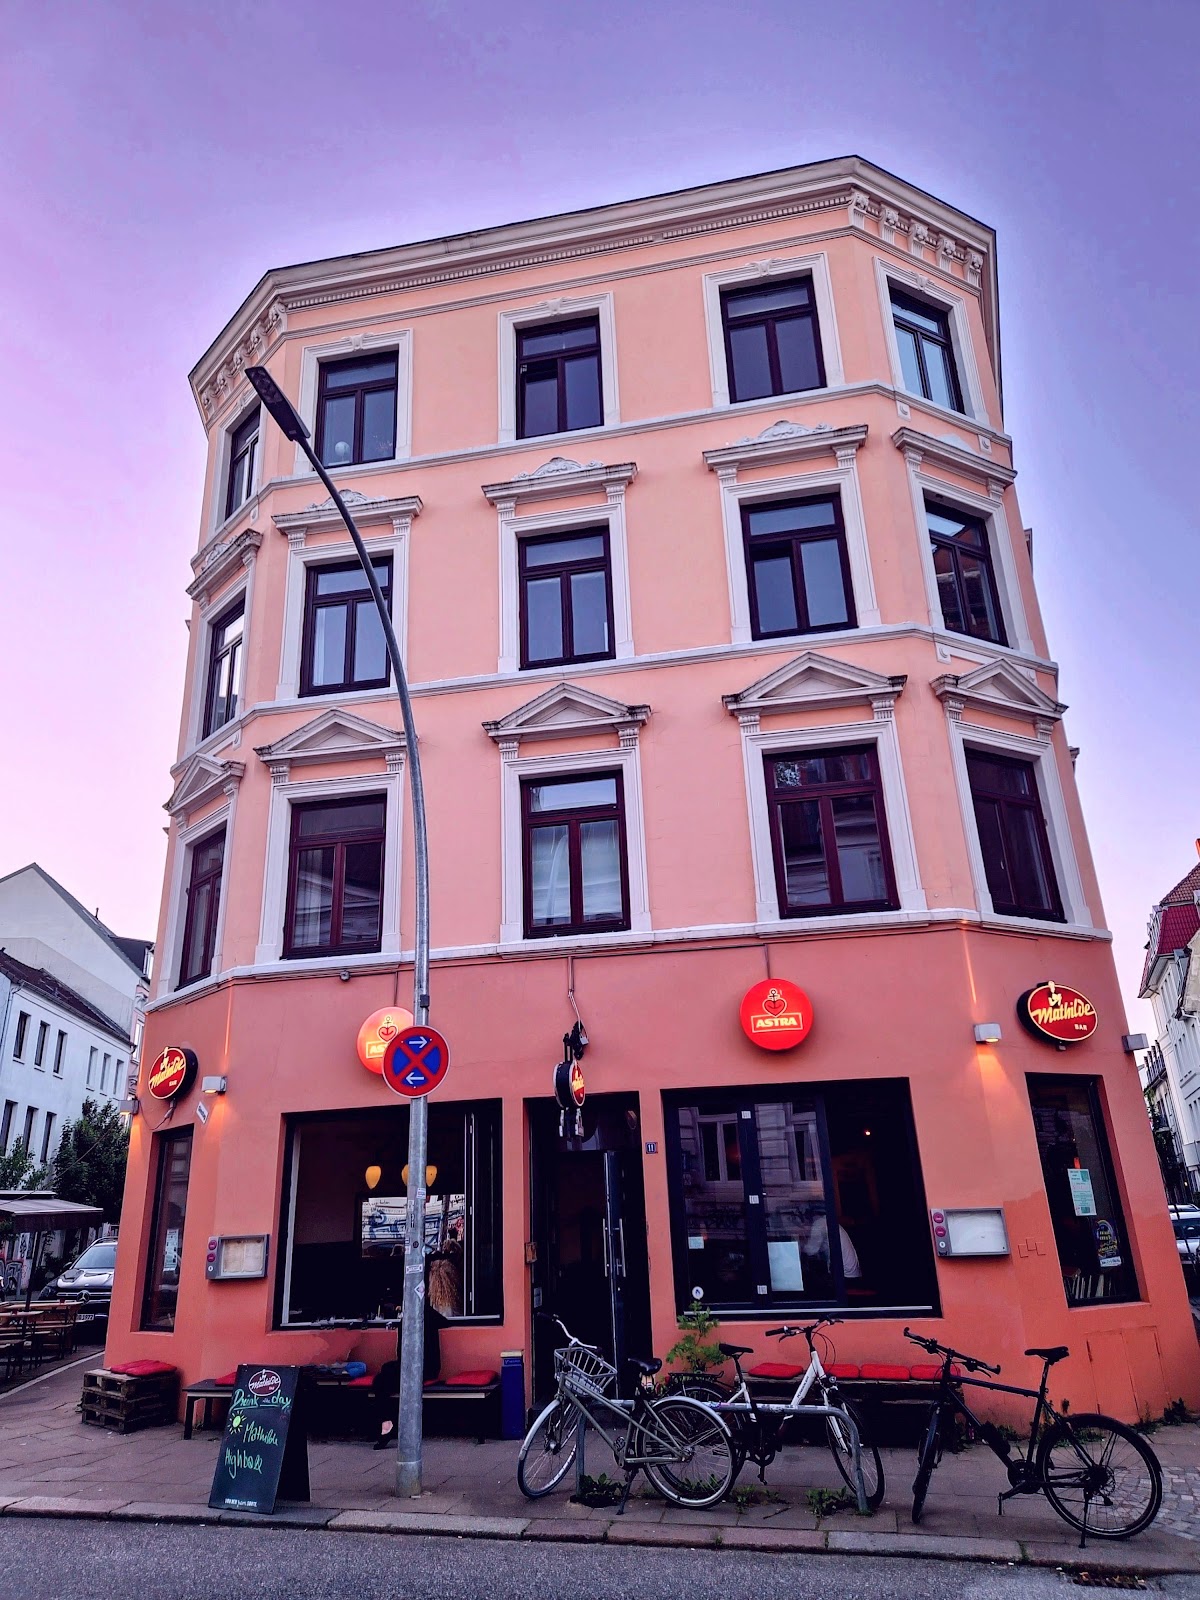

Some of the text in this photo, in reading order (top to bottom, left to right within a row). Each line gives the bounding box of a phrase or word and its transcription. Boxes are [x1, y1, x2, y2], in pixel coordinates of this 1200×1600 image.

[1031, 998, 1095, 1024] Mathilde
[756, 1017, 798, 1028] ASTRA
[1074, 1023, 1088, 1031] BAR
[647, 1143, 655, 1152] 11
